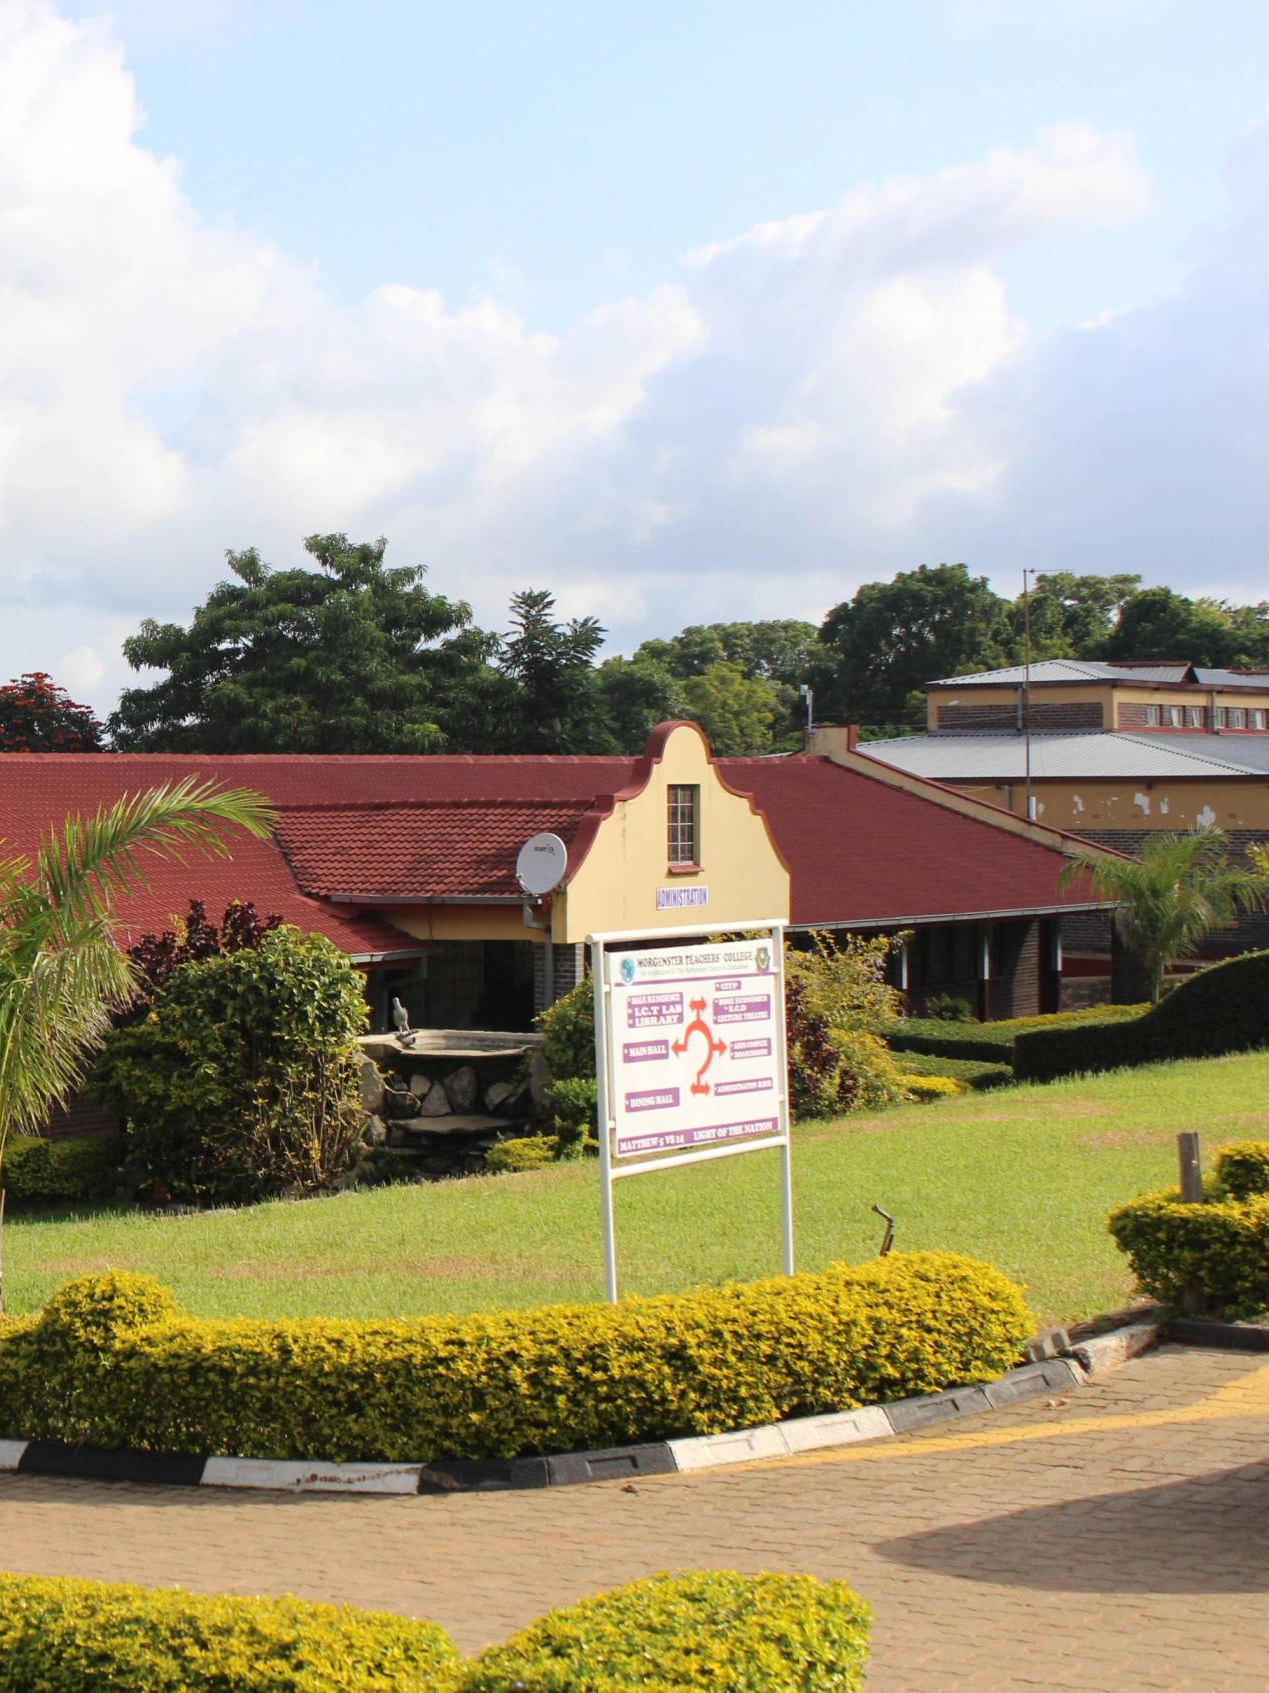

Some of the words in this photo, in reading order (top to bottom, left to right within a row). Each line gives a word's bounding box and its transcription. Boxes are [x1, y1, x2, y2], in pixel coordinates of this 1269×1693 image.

[658, 888, 707, 907] ADMINISTRATION
[637, 955, 683, 968] MORGENSTER
[723, 951, 753, 963] COLLEGE
[661, 1004, 683, 1015] LAB
[634, 1014, 679, 1027] LIBRARY
[628, 1046, 647, 1057] MAIN
[647, 1044, 667, 1055] HALL
[630, 1096, 656, 1108] DINING
[655, 1094, 674, 1105] HALL
[693, 1129, 716, 1141] LIGHT
[717, 1127, 729, 1138] OF
[729, 1125, 744, 1136] THE
[744, 1121, 773, 1133] NATION
[619, 1136, 659, 1152] MATTHEW
[659, 1137, 665, 1147] 5
[664, 1135, 675, 1145] VS
